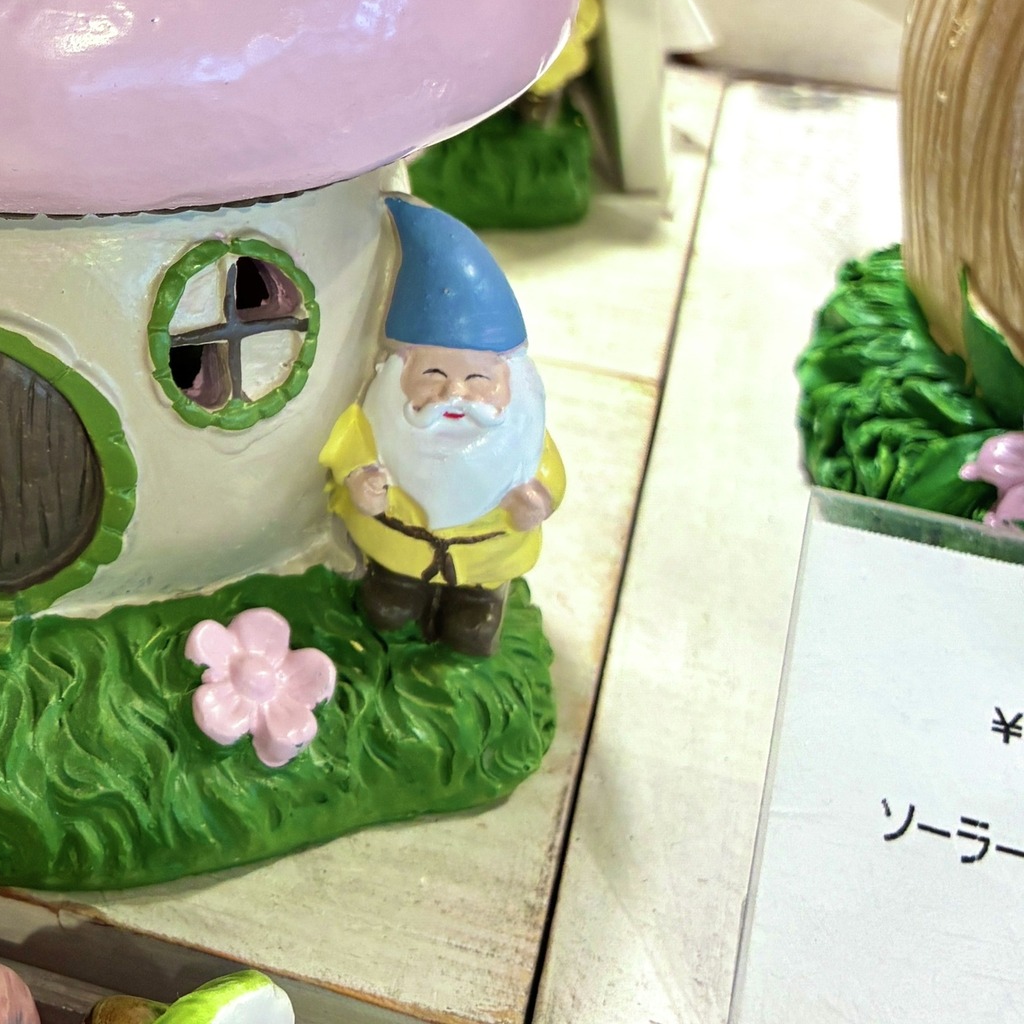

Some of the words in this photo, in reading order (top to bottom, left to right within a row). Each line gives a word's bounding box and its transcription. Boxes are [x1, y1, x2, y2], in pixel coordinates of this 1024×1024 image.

[991, 706, 1023, 744] ¥
[881, 798, 1024, 864] ソーラー
